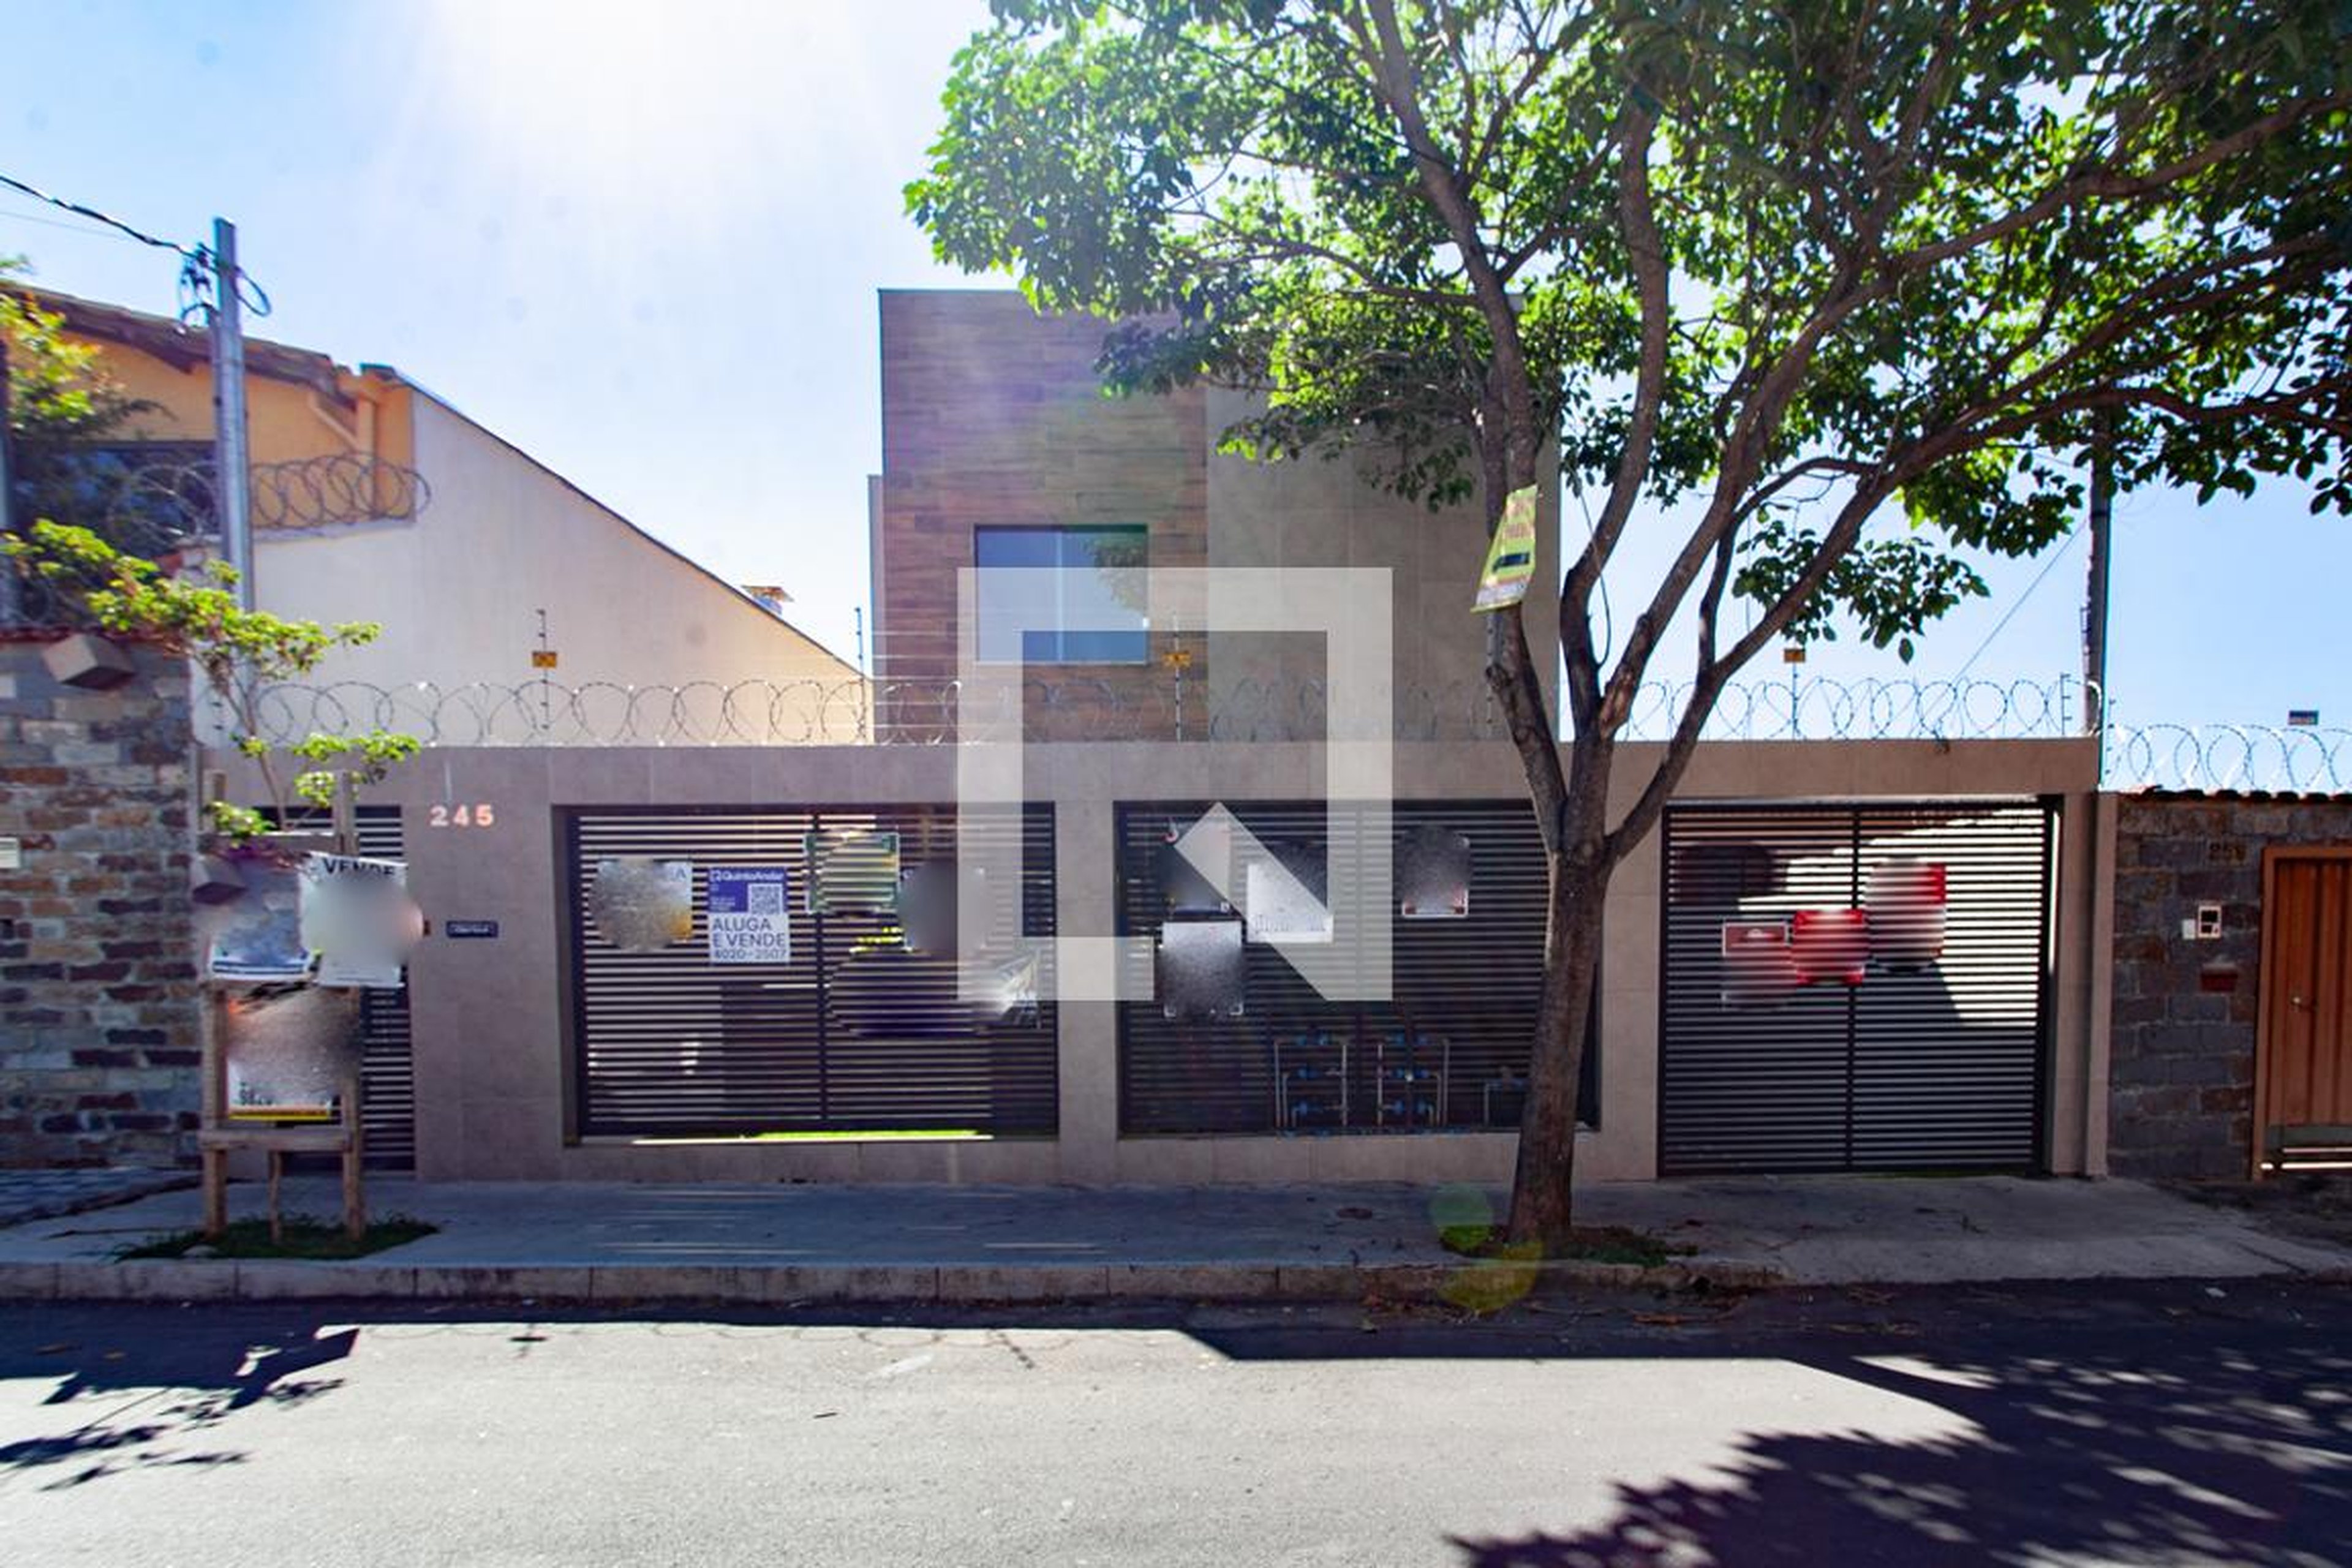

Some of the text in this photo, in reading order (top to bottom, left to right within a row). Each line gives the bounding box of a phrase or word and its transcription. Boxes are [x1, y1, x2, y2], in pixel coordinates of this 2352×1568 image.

[431, 804, 494, 827] 245
[713, 918, 772, 932] ALUGA
[714, 933, 786, 948] E VENDE
